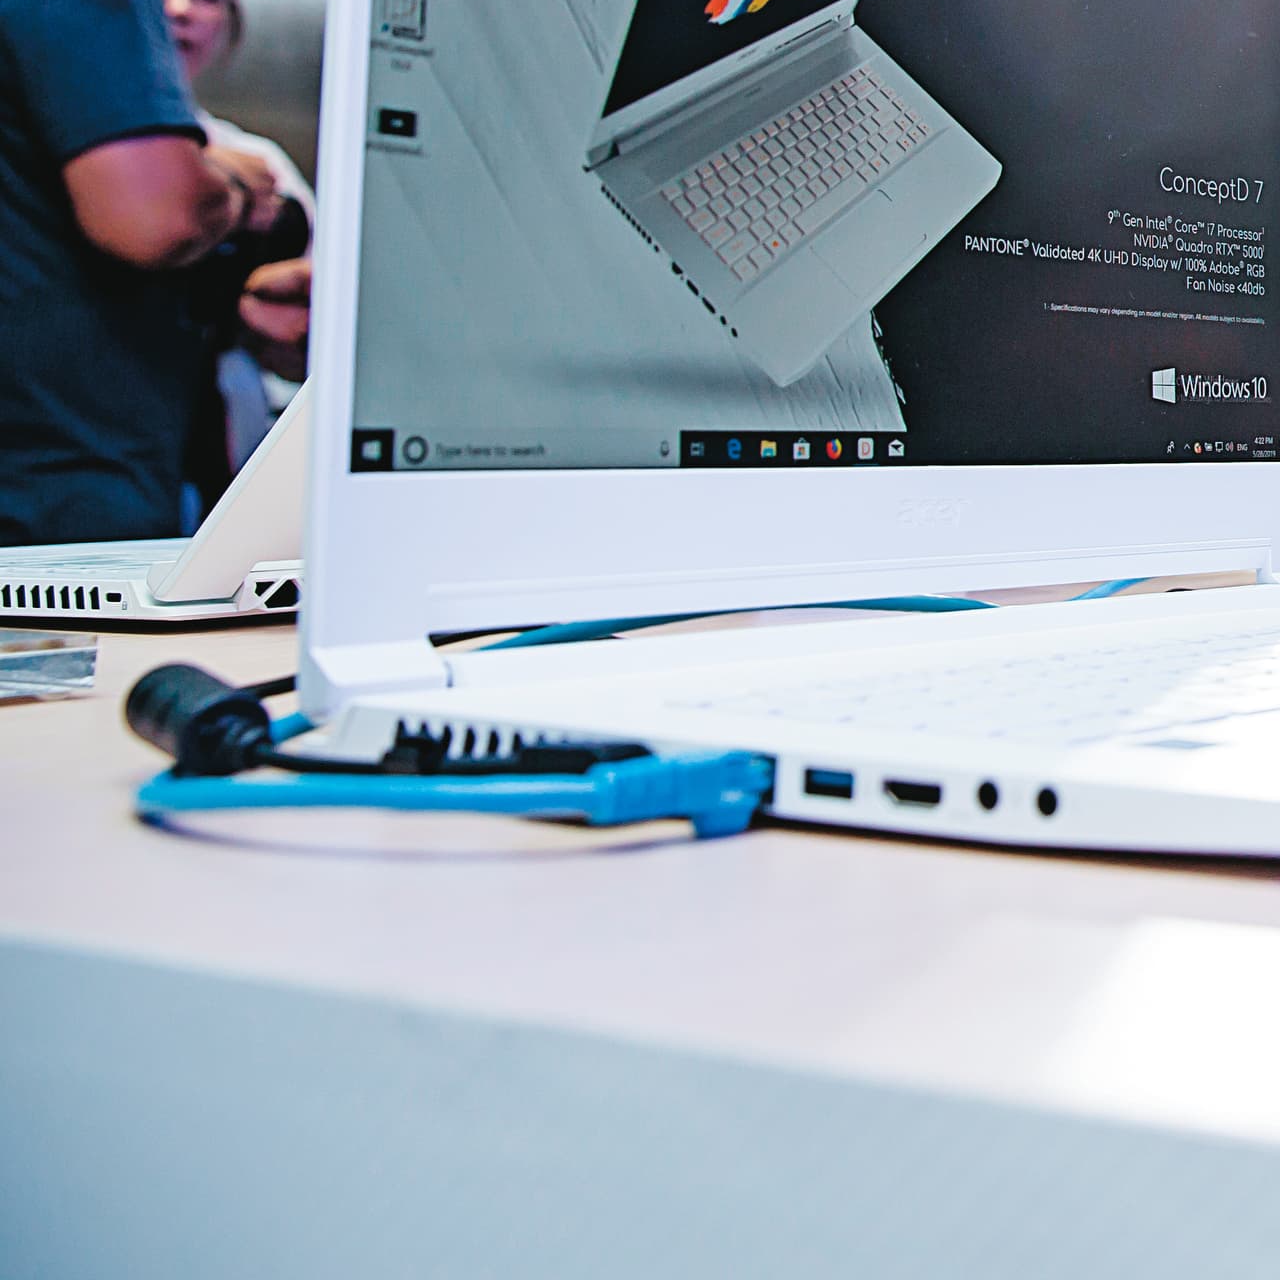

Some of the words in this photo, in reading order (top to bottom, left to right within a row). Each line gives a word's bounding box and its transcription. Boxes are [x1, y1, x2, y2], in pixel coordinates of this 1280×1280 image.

[1159, 167, 1249, 204] ConceptD
[1254, 180, 1264, 204] 7
[1122, 213, 1143, 228] Gen
[1207, 223, 1215, 236] i7
[1175, 238, 1214, 255] Quadro
[1031, 242, 1085, 261] Validated
[1087, 248, 1101, 262] 4K
[1104, 250, 1129, 265] UHD
[1131, 252, 1168, 271] Display
[1170, 257, 1182, 271] w/
[1185, 257, 1207, 273] 100%
[1247, 264, 1265, 278] RGB
[1186, 276, 1206, 291] Fan
[1208, 279, 1235, 293] Noise
[1237, 281, 1265, 296] <40db
[1181, 374, 1250, 399] Windows
[1251, 376, 1267, 399] 10
[1237, 443, 1248, 452] ENG
